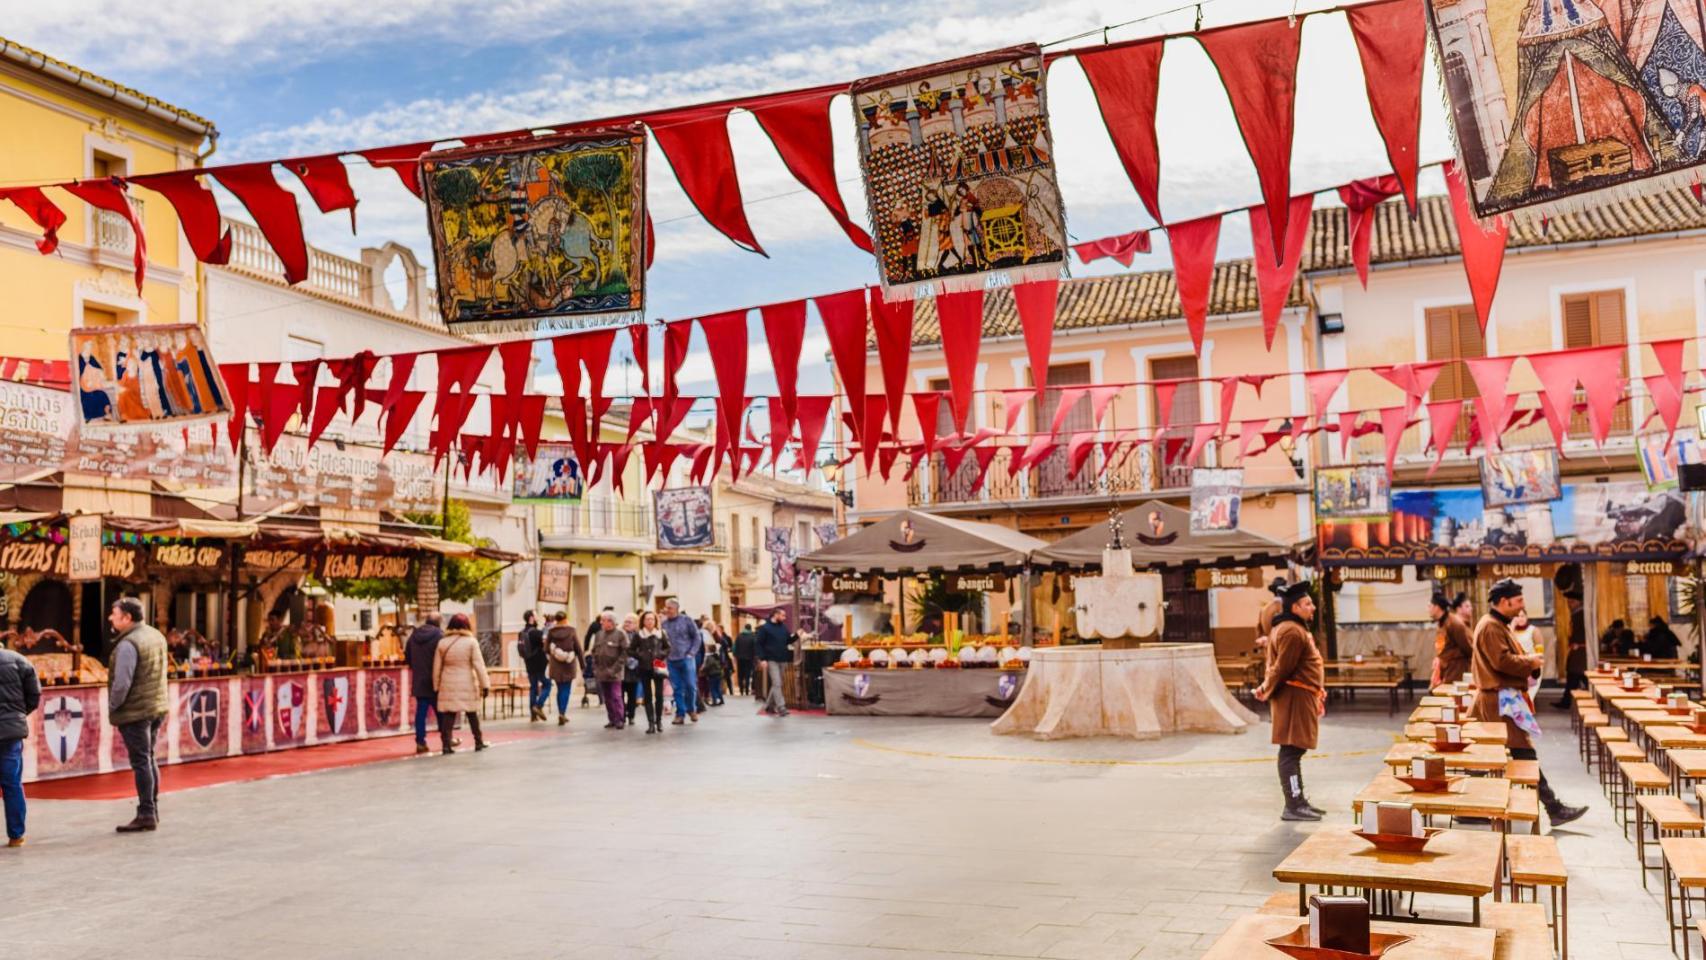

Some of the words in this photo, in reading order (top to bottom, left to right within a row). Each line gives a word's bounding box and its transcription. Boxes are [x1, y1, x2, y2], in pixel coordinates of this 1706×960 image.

[1339, 566, 1397, 581] Puntillitas
[1492, 562, 1541, 577] Chorizos
[1626, 561, 1673, 576] Secreto
[831, 575, 869, 592] Chorizos
[1210, 570, 1249, 586] Bravas
